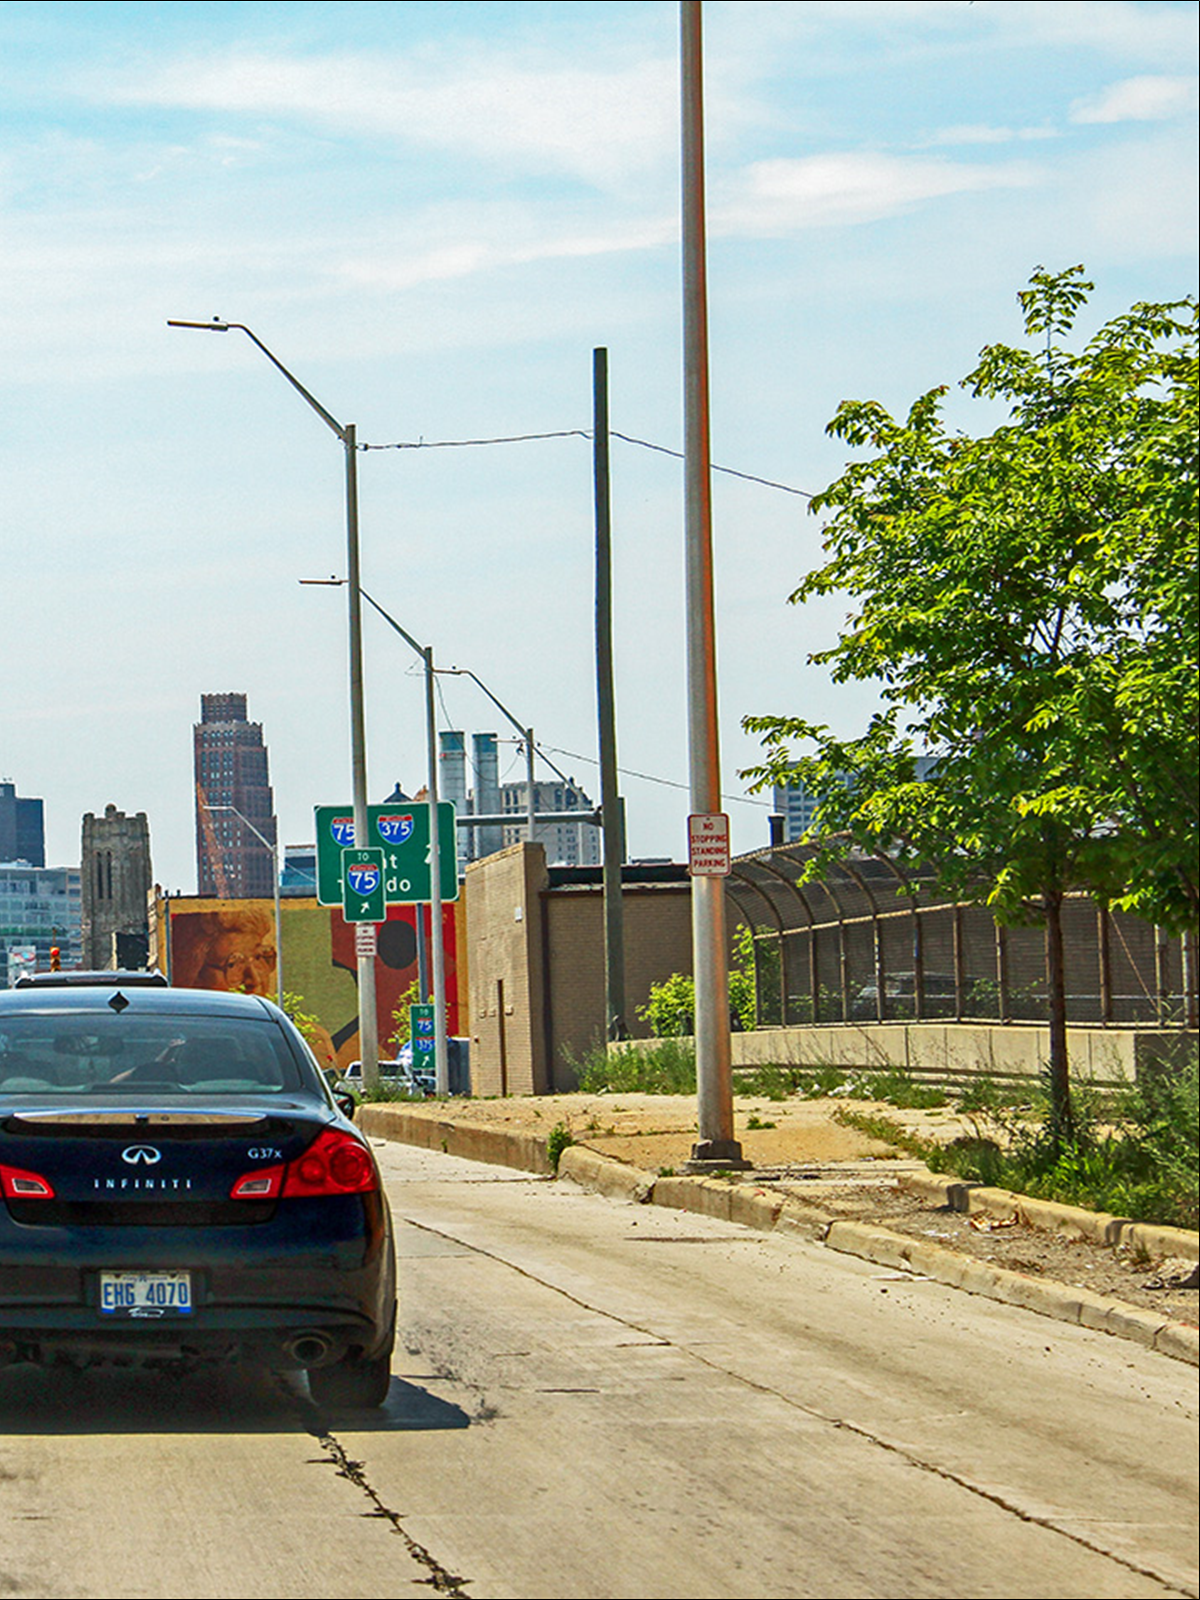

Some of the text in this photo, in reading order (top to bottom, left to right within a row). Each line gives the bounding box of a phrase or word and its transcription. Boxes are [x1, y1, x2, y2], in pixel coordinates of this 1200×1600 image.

[333, 824, 356, 840] 75
[381, 821, 410, 836] 375
[703, 822, 714, 831] NO
[691, 834, 727, 844] STOPPING
[357, 852, 370, 861] TO
[691, 846, 727, 856] STANDING
[694, 858, 726, 868] PARKING
[351, 872, 376, 889] 75
[419, 1020, 432, 1031] 75
[248, 1147, 282, 1159] G37x
[93, 1178, 192, 1189] INFINITI
[103, 1282, 188, 1306] EHG 4070
